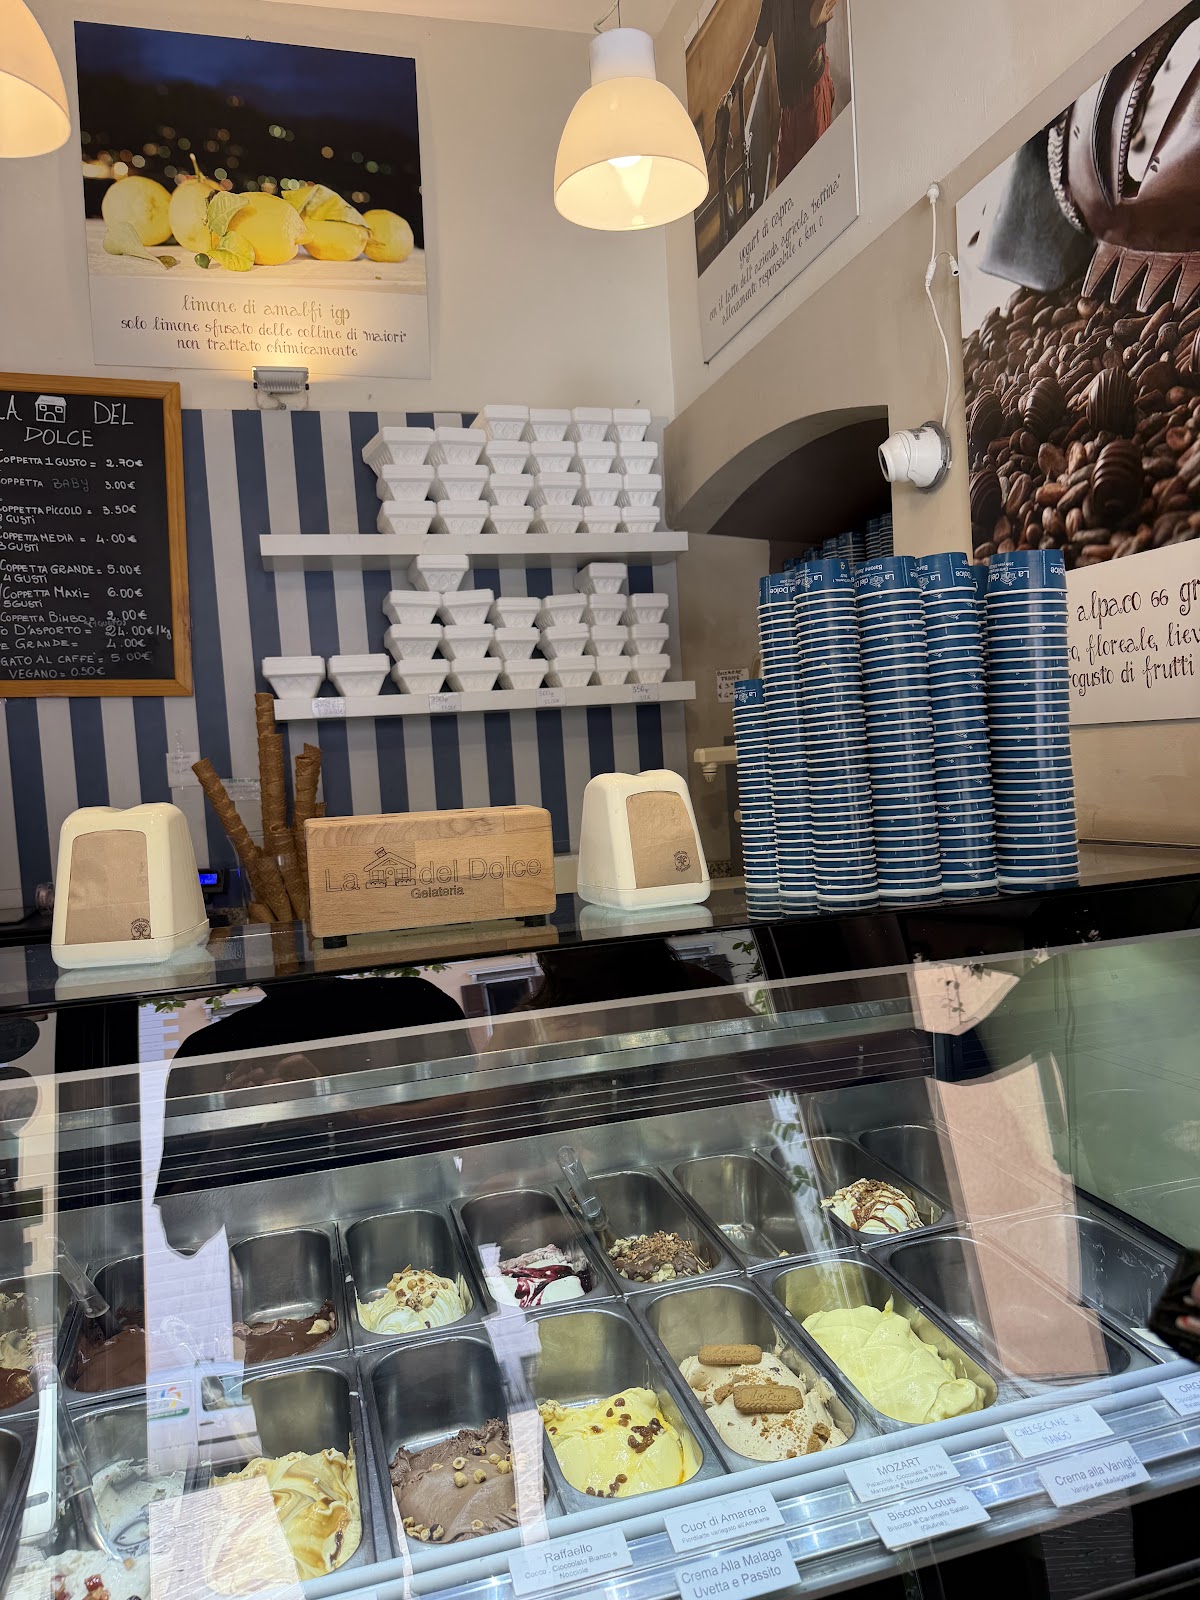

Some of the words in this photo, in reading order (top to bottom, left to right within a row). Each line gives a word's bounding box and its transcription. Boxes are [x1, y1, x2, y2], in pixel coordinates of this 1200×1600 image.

[739, 227, 760, 269] yogurt
[762, 215, 769, 238] di
[770, 197, 794, 228] capra
[718, 295, 724, 310] il
[726, 284, 739, 304] latte
[755, 242, 779, 274] azienda
[780, 209, 808, 248] agricola
[722, 282, 758, 326] allevamento
[758, 241, 796, 288] responsabile
[798, 237, 802, 248] e
[804, 222, 816, 242] km
[182, 294, 236, 312] limone
[243, 300, 256, 314] di
[264, 302, 322, 322] amalfi
[330, 304, 350, 325] igp
[121, 316, 147, 330] solo
[152, 316, 200, 332] limone
[205, 319, 254, 338] sfusato
[258, 322, 292, 336] delle
[297, 324, 342, 339] colline
[346, 326, 358, 340] di
[176, 337, 200, 350] non
[207, 338, 262, 352] trattato
[266, 340, 358, 357] chimicamente
[94, 401, 134, 425] DEL
[24, 426, 94, 447] DOLCE
[45, 457, 54, 466] 1
[56, 458, 87, 467] GUSTO
[106, 458, 144, 468] 2.70€
[105, 480, 136, 490] 3.00€
[102, 504, 137, 514] 3.50€
[40, 534, 74, 543] MEDIA
[96, 534, 137, 544] 4.00€
[3, 574, 12, 582] 4
[50, 564, 95, 574] GRANDE
[107, 564, 142, 575] 5.00€
[1018, 570, 1029, 578] La
[3, 586, 50, 599] COPPETTA
[108, 587, 144, 598] 6.00€
[1, 612, 45, 622] COPPETTA
[106, 610, 147, 621] 2.00€
[1077, 590, 1142, 629] alpaco
[1151, 589, 1168, 608] 66
[15, 624, 82, 636] D'ASPORTO
[16, 638, 69, 649] GRANDE
[106, 639, 146, 648] 4.00€
[1086, 627, 1158, 665] floreale,
[36, 655, 52, 664] AL
[111, 652, 152, 662] 5.00€
[9, 669, 57, 679] VEGANO
[71, 667, 105, 677] 0.50€
[1121, 661, 1135, 683] di
[1142, 654, 1195, 688] frutti
[324, 869, 360, 892] La
[418, 860, 458, 884] del
[468, 856, 542, 881] Dolce
[410, 886, 464, 899] Gelateria
[1178, 1378, 1200, 1393] ORG
[1014, 1418, 1069, 1437] CHEESECAKE
[1042, 1431, 1072, 1445] MANGO
[876, 1456, 921, 1476] MOZART
[1054, 1472, 1087, 1486] Crema
[1088, 1466, 1104, 1478] alla
[866, 1477, 893, 1490] Pistacchio
[896, 1469, 923, 1480] Cioccolato
[1071, 1483, 1094, 1494] Vaniglia
[1094, 1480, 1104, 1488] del
[1104, 1471, 1136, 1485] Madagascar
[887, 1504, 928, 1521] Biscotto
[928, 1497, 956, 1510] Lotus
[887, 1521, 912, 1532] Biscotto
[919, 1511, 949, 1523] Caramello
[950, 1505, 969, 1513] Salato
[681, 1521, 706, 1534] Cuor
[709, 1516, 719, 1526] di
[721, 1505, 766, 1523] Amarena
[682, 1532, 710, 1543] Fiordilatte
[710, 1525, 736, 1536] variegato
[544, 1544, 592, 1563] Raffaello
[525, 1568, 547, 1579] Cocco
[552, 1559, 588, 1572] Cioccolato
[589, 1552, 611, 1562] Bianco
[560, 1568, 588, 1579] Nocciole
[682, 1566, 718, 1584] Crema
[721, 1559, 740, 1573] Alla
[742, 1548, 782, 1567] Malaga
[694, 1582, 730, 1599] Uvetta
[732, 1579, 740, 1588] e
[741, 1566, 782, 1585] Passito
